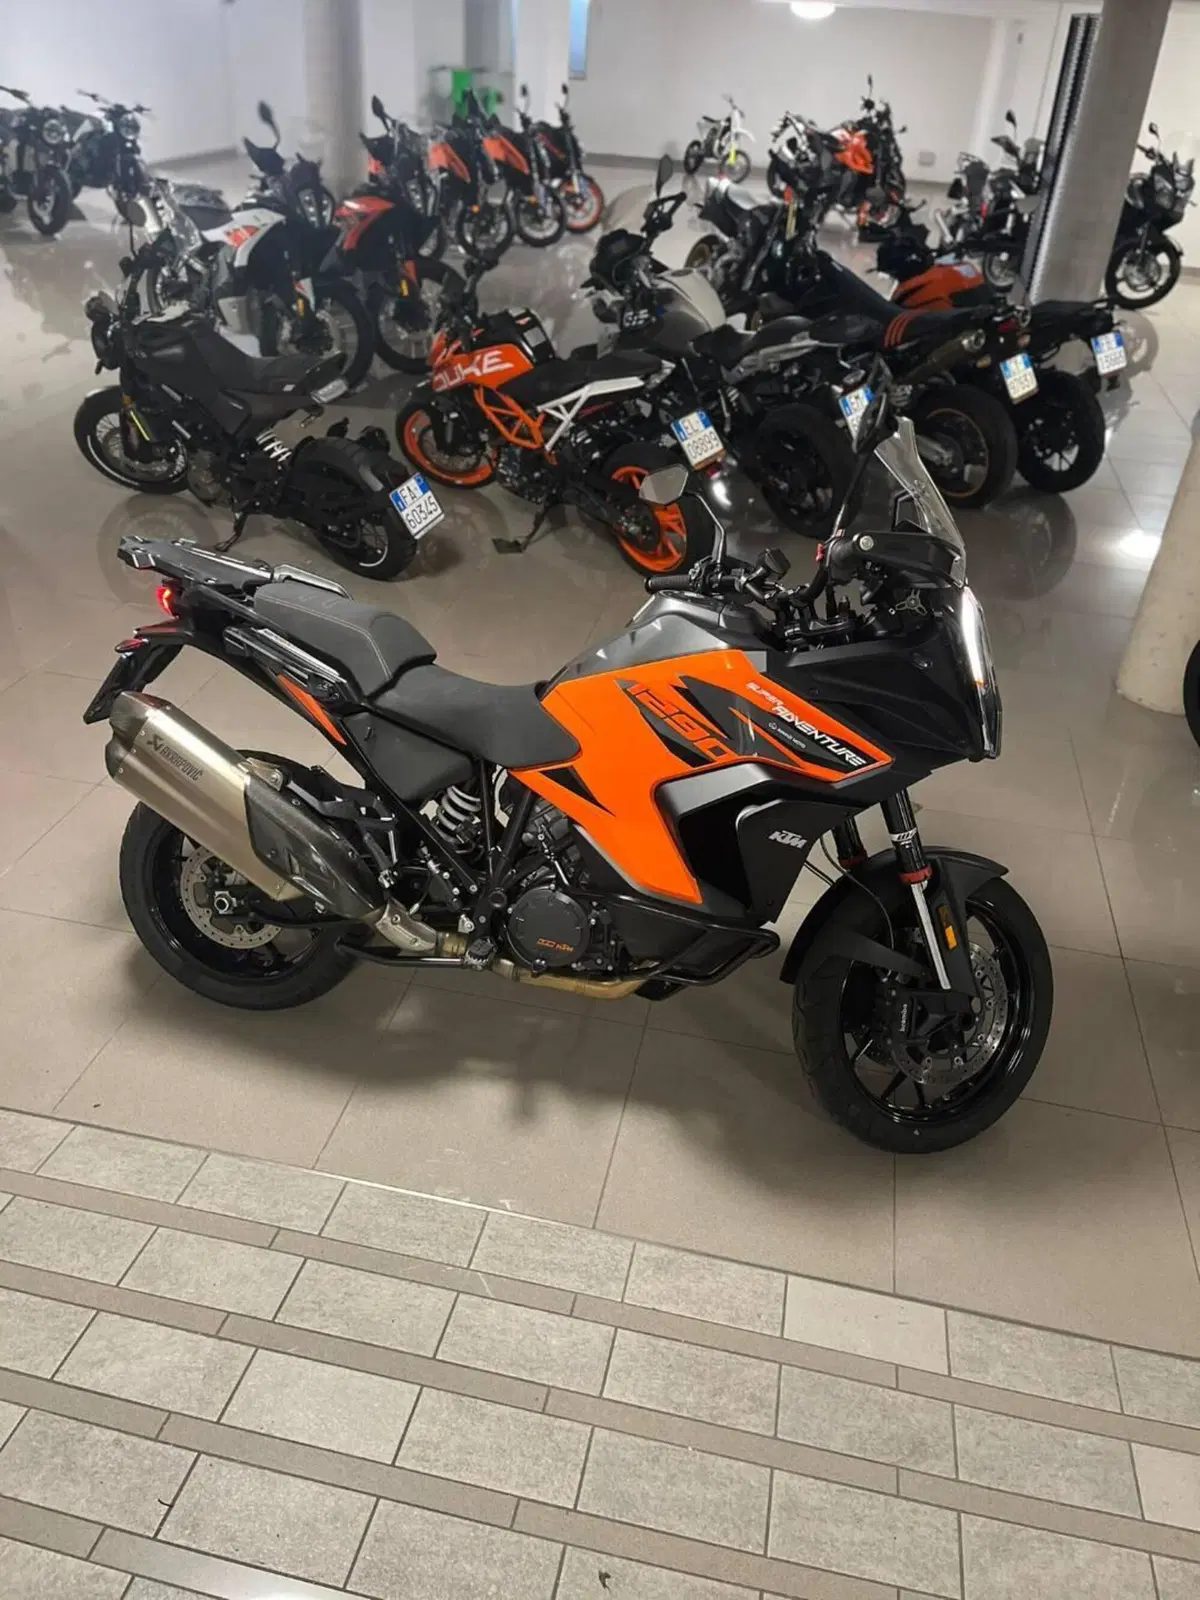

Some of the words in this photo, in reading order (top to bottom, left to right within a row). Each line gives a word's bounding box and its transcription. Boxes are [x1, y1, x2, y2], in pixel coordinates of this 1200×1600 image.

[400, 486, 418, 506] FA
[405, 496, 439, 529] 60345
[627, 683, 739, 762] 1290
[772, 705, 867, 767] ADVENTURE
[768, 830, 808, 849] KTM
[899, 1003, 908, 1032] brembo
